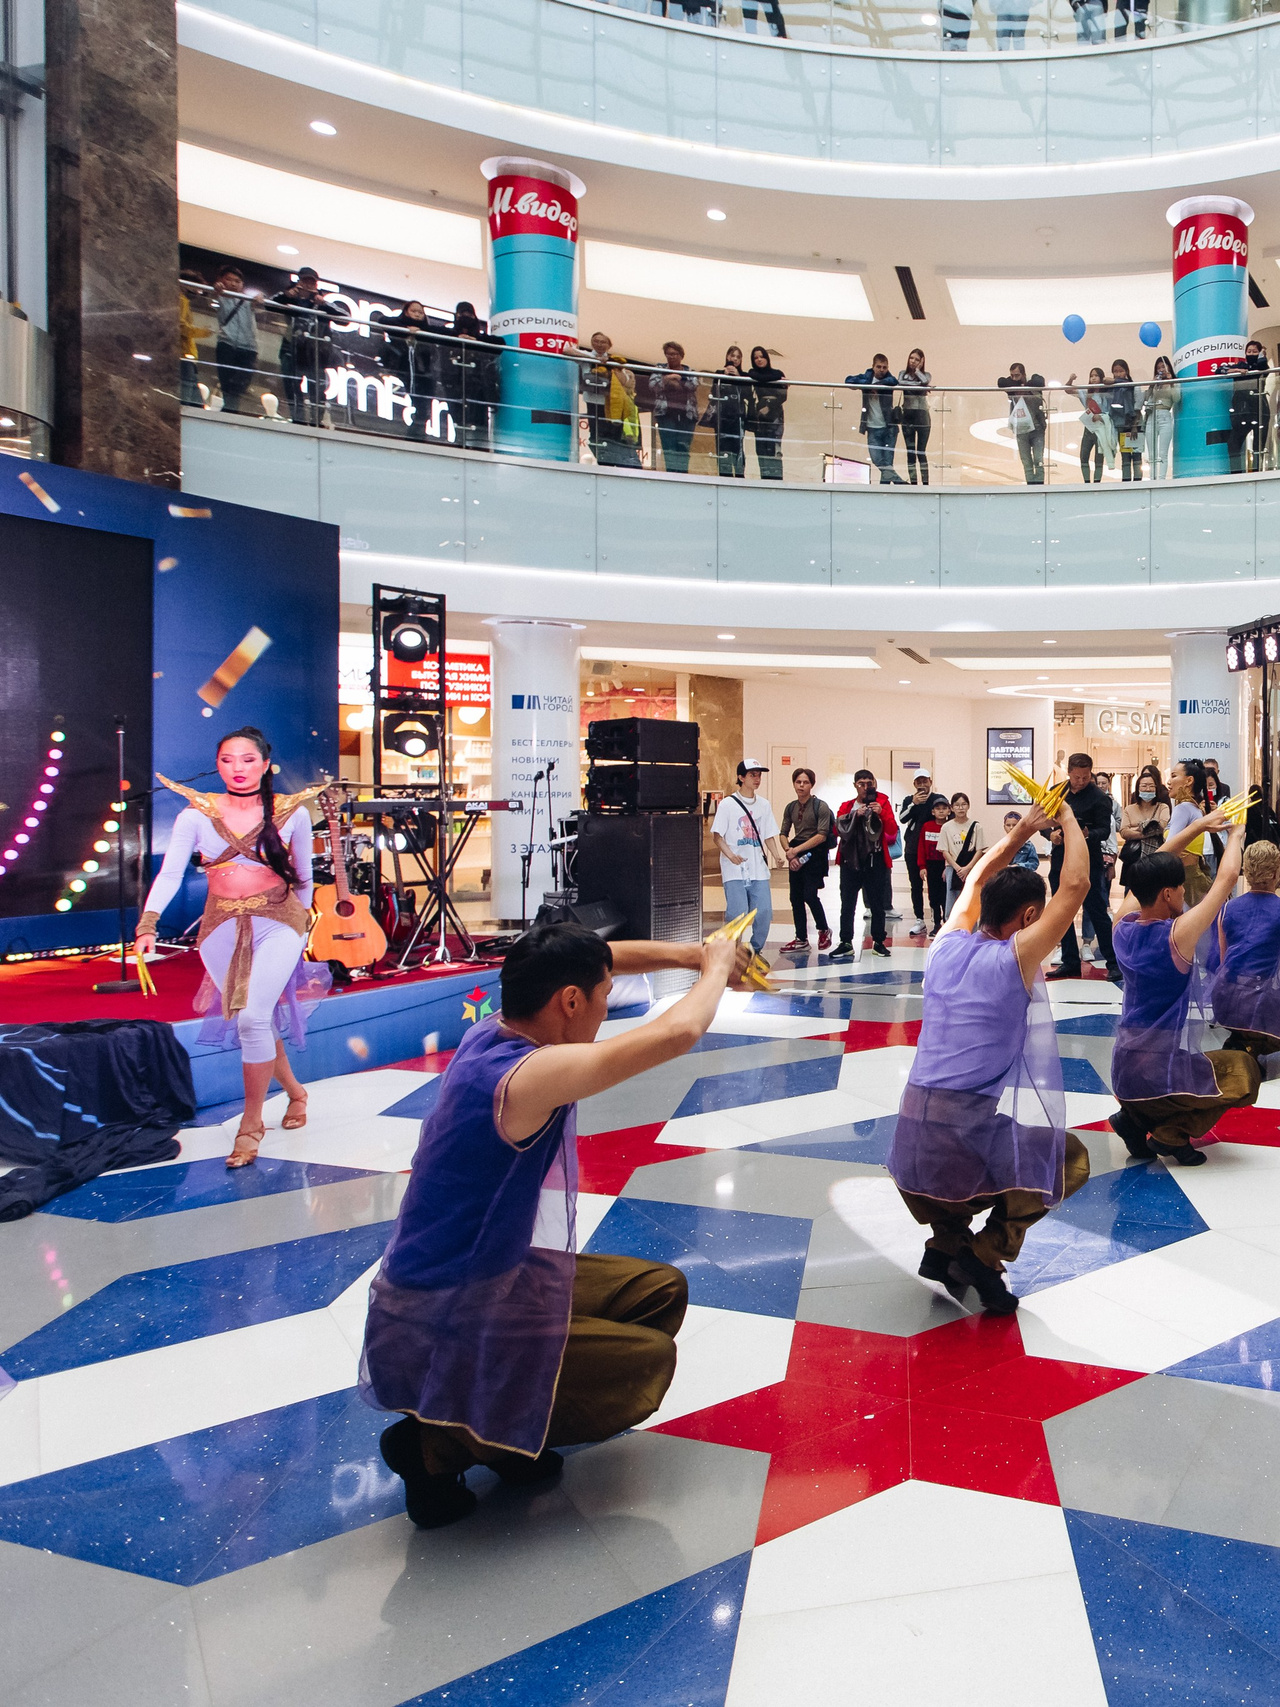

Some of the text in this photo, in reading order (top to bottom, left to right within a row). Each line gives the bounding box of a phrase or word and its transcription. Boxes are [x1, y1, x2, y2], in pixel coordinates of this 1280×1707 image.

[1174, 226, 1248, 259] М.видео
[535, 337, 543, 347] 3
[422, 660, 485, 672] КОМЕТИКА
[411, 670, 458, 681] БЫТОАЯ
[543, 694, 573, 704] ЧИТАЙ
[1201, 698, 1230, 707] ЧИТАЙ
[543, 703, 574, 713] ГОРОД
[1201, 706, 1231, 716] ГОРОД
[511, 739, 574, 748] БЕСТСЕЛЛЕРЫ
[1177, 741, 1231, 749] БЕСТСЕЛЛЕРЫ
[510, 843, 517, 854] 3
